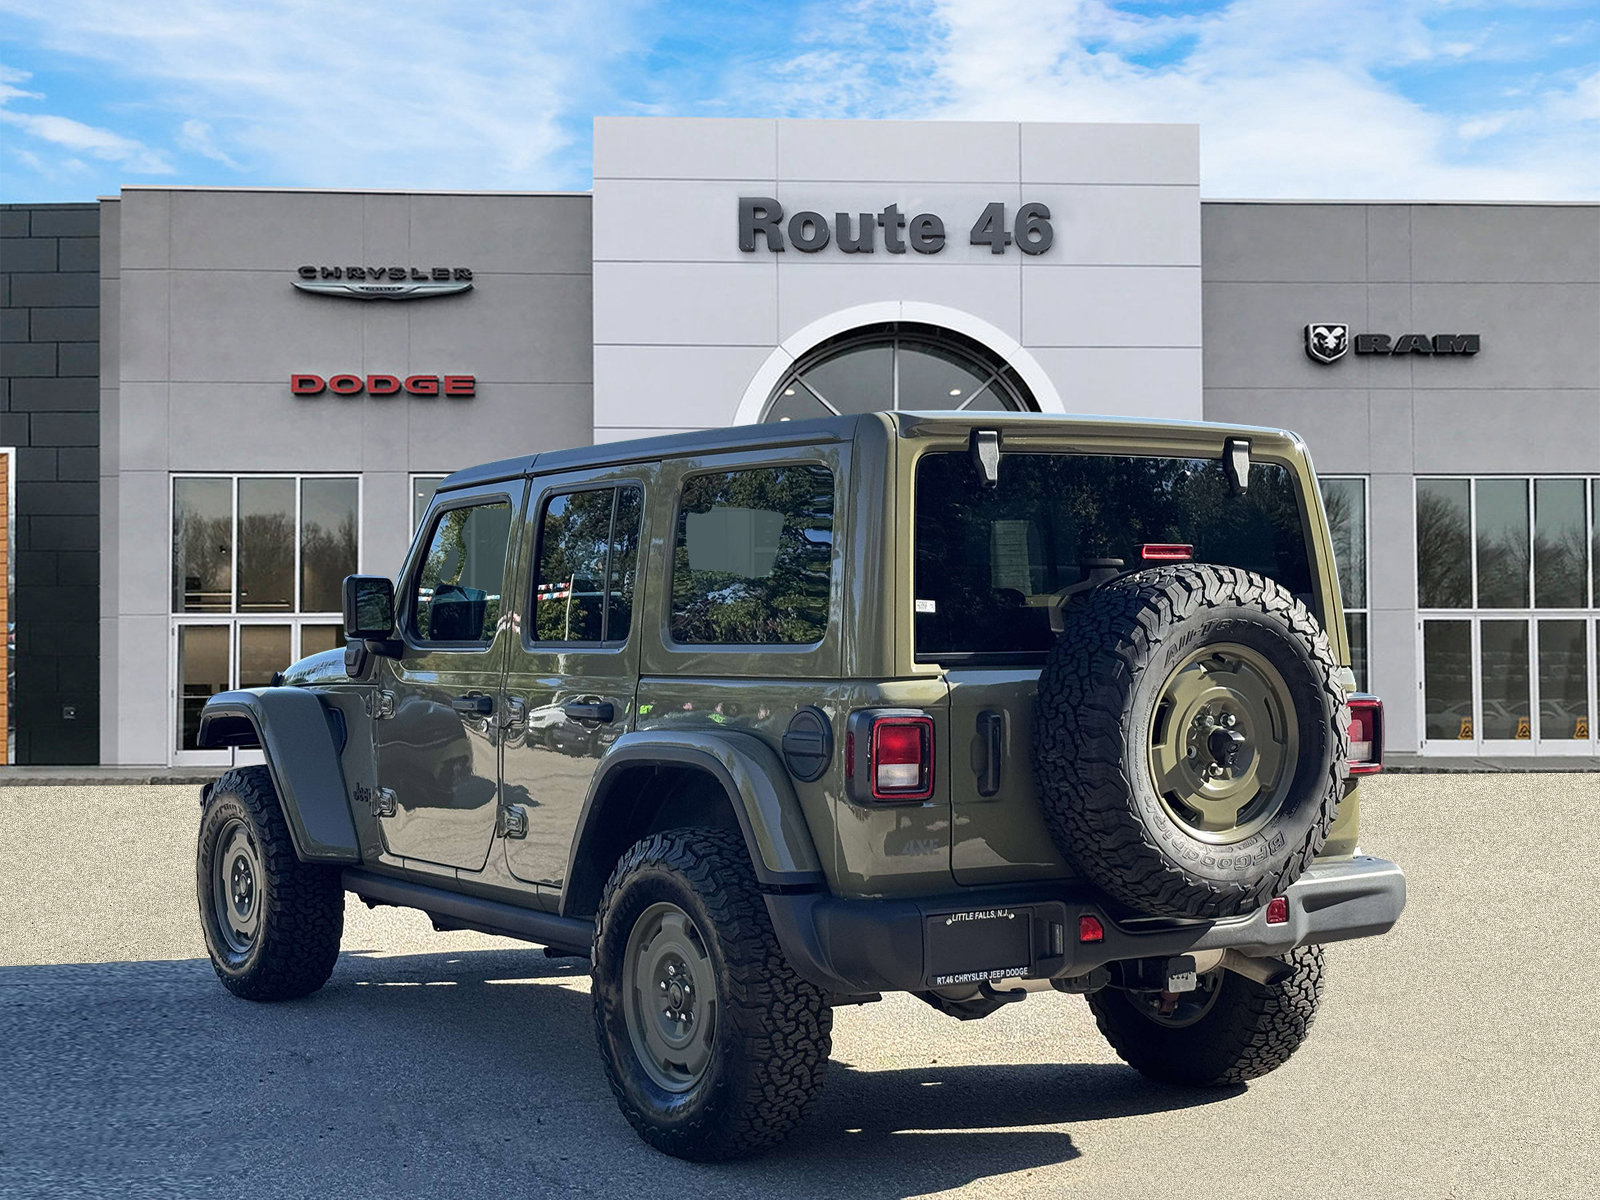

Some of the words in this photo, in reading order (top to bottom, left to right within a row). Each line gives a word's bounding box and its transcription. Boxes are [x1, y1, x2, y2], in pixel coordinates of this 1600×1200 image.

[738, 196, 946, 255] Route
[969, 202, 1054, 256] 46
[297, 265, 473, 281] CHRYSLER
[1354, 333, 1480, 356] RAM
[291, 374, 476, 397] DODGE
[1144, 794, 1286, 871] BFGoodrich
[951, 912, 974, 922] LITTLE
[974, 910, 997, 920] FALLS,
[936, 975, 954, 985] RT.46
[954, 971, 989, 983] CHRYSLER
[989, 969, 1005, 979] JEEP
[1005, 966, 1029, 977] DODGE
